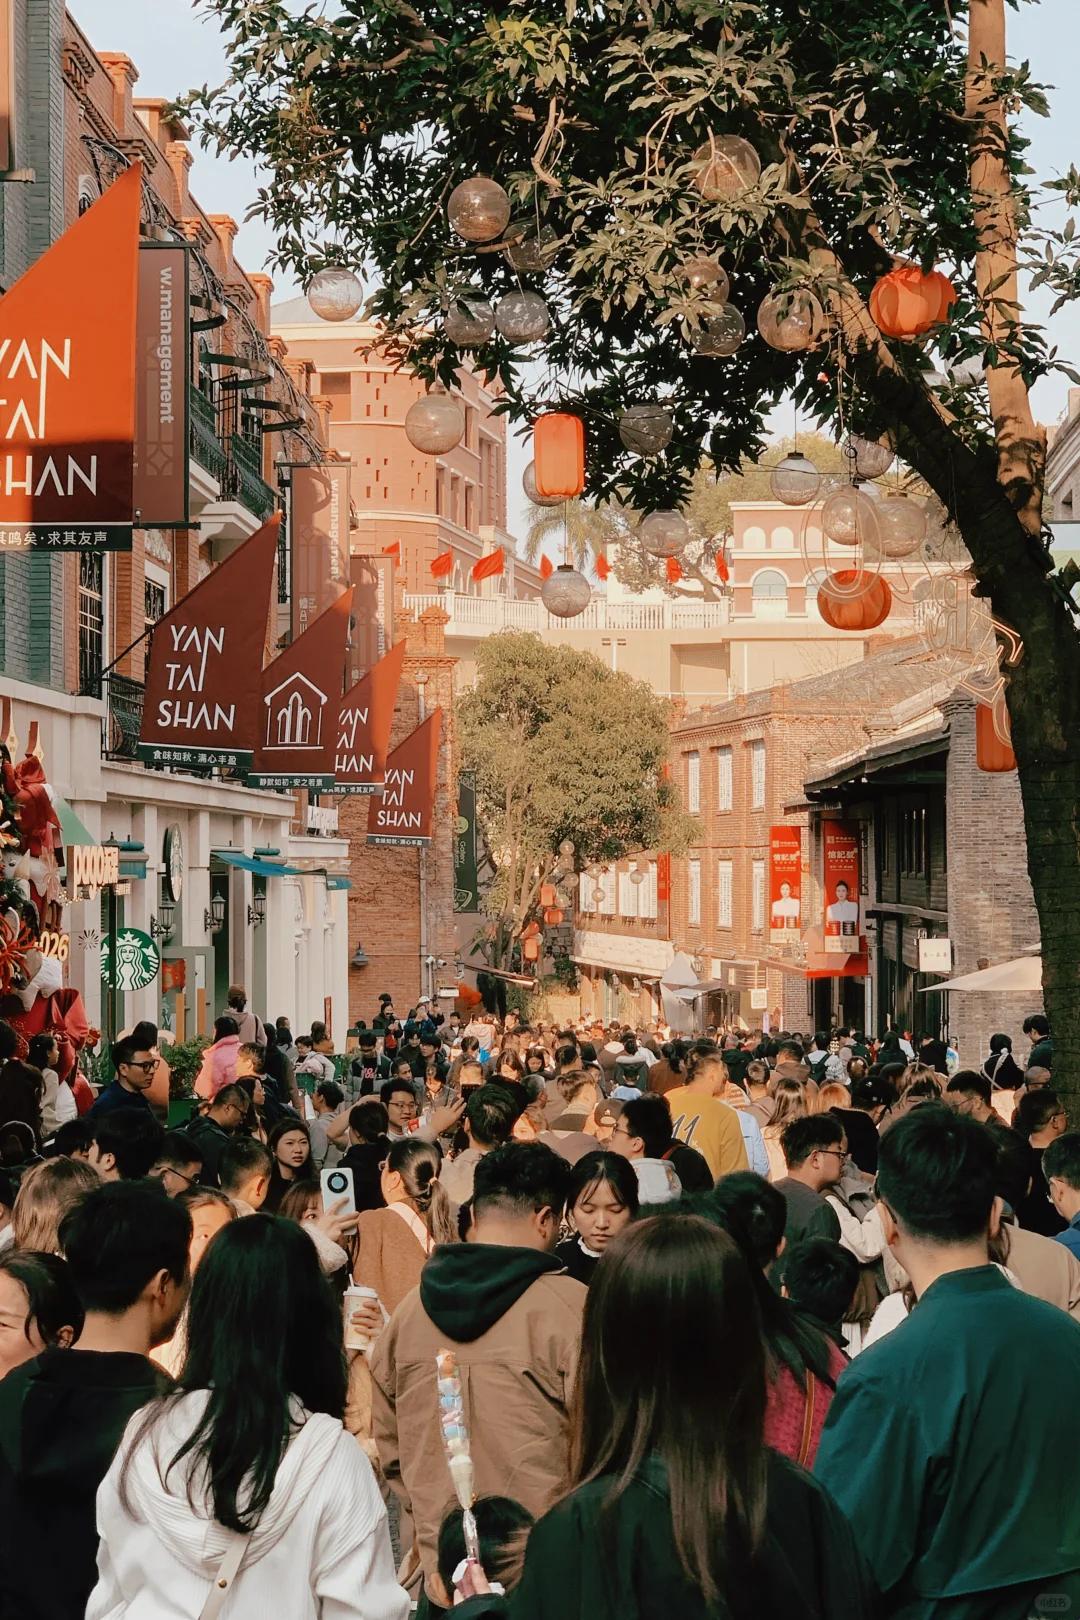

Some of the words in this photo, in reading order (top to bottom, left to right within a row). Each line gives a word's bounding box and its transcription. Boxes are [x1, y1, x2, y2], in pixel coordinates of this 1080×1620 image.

[157, 267, 174, 424] w.management
[0, 455, 97, 496] HAN
[170, 624, 225, 655] YAN
[157, 699, 236, 732] SHAN
[334, 754, 373, 773] HAN
[376, 809, 422, 828] SHAN
